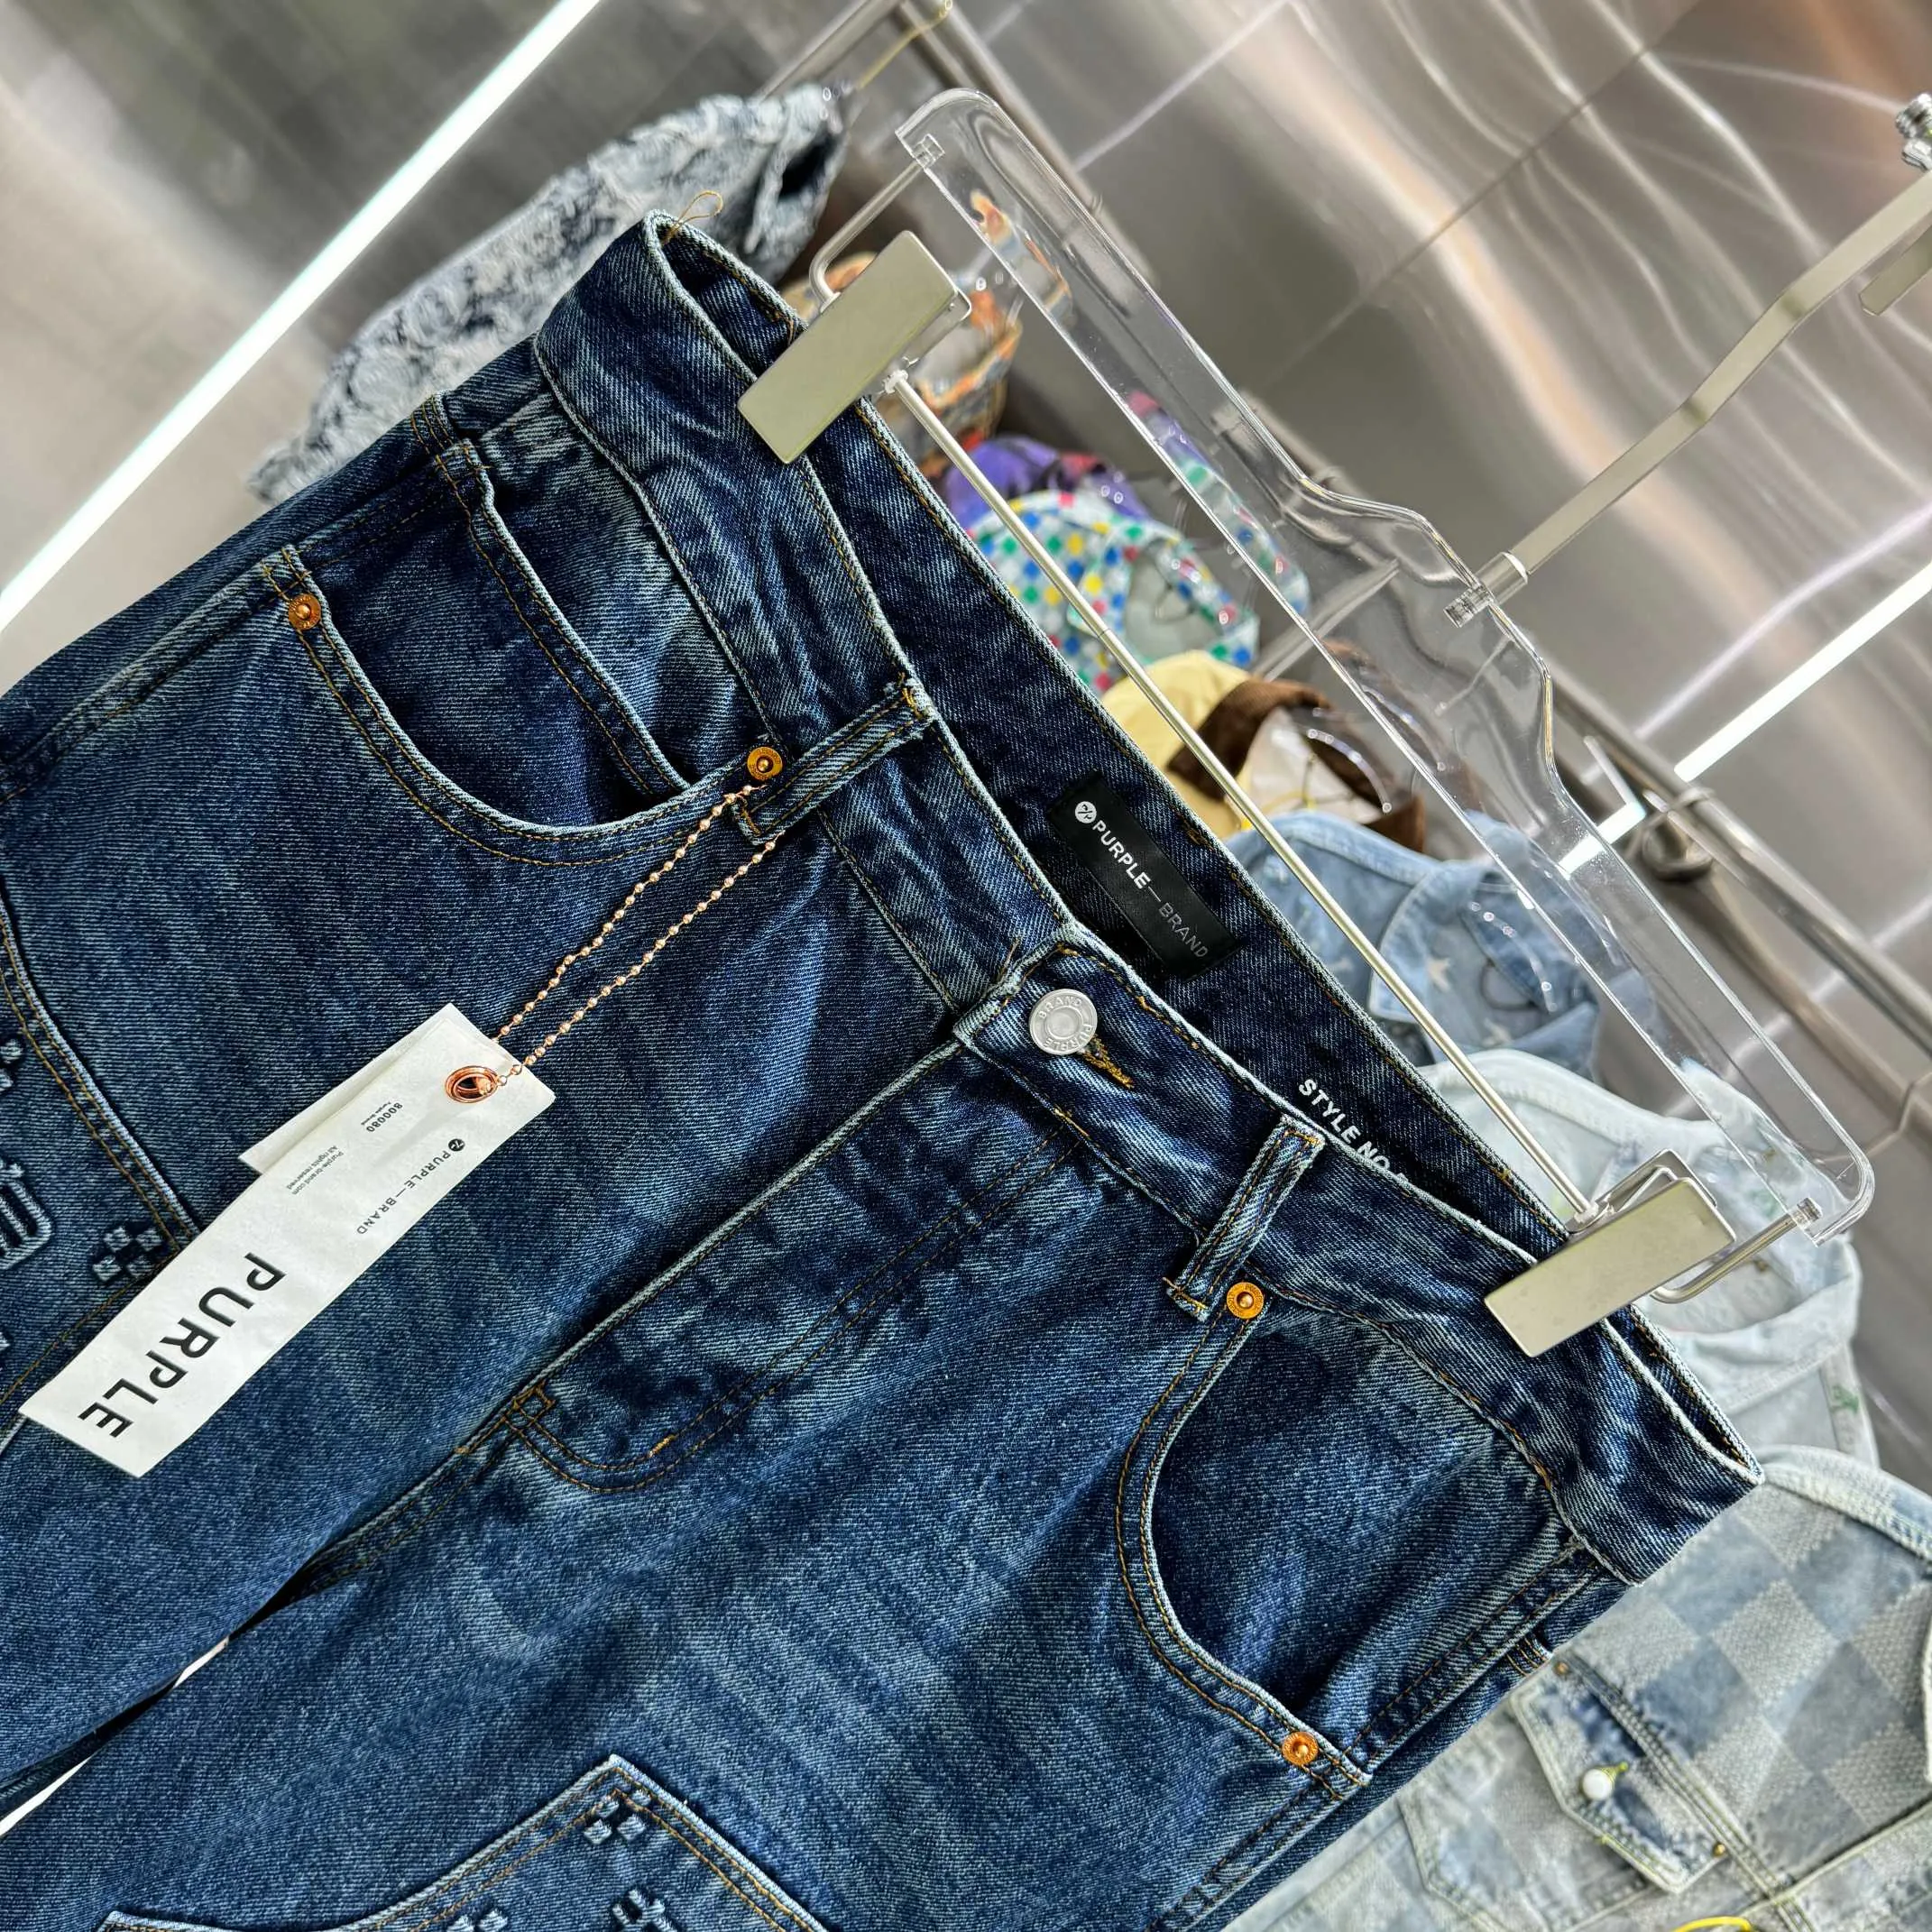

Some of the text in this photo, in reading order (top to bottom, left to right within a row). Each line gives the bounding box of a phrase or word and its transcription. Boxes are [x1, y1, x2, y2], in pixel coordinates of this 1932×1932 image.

[1092, 820, 1209, 958] PURPLE BRAND
[1038, 995, 1082, 1019] BRAND
[366, 1102, 403, 1133] 800080
[1298, 1079, 1362, 1145] STYLE
[356, 1150, 451, 1235] PURPLE BRAND
[77, 1252, 287, 1438] PURPLE
